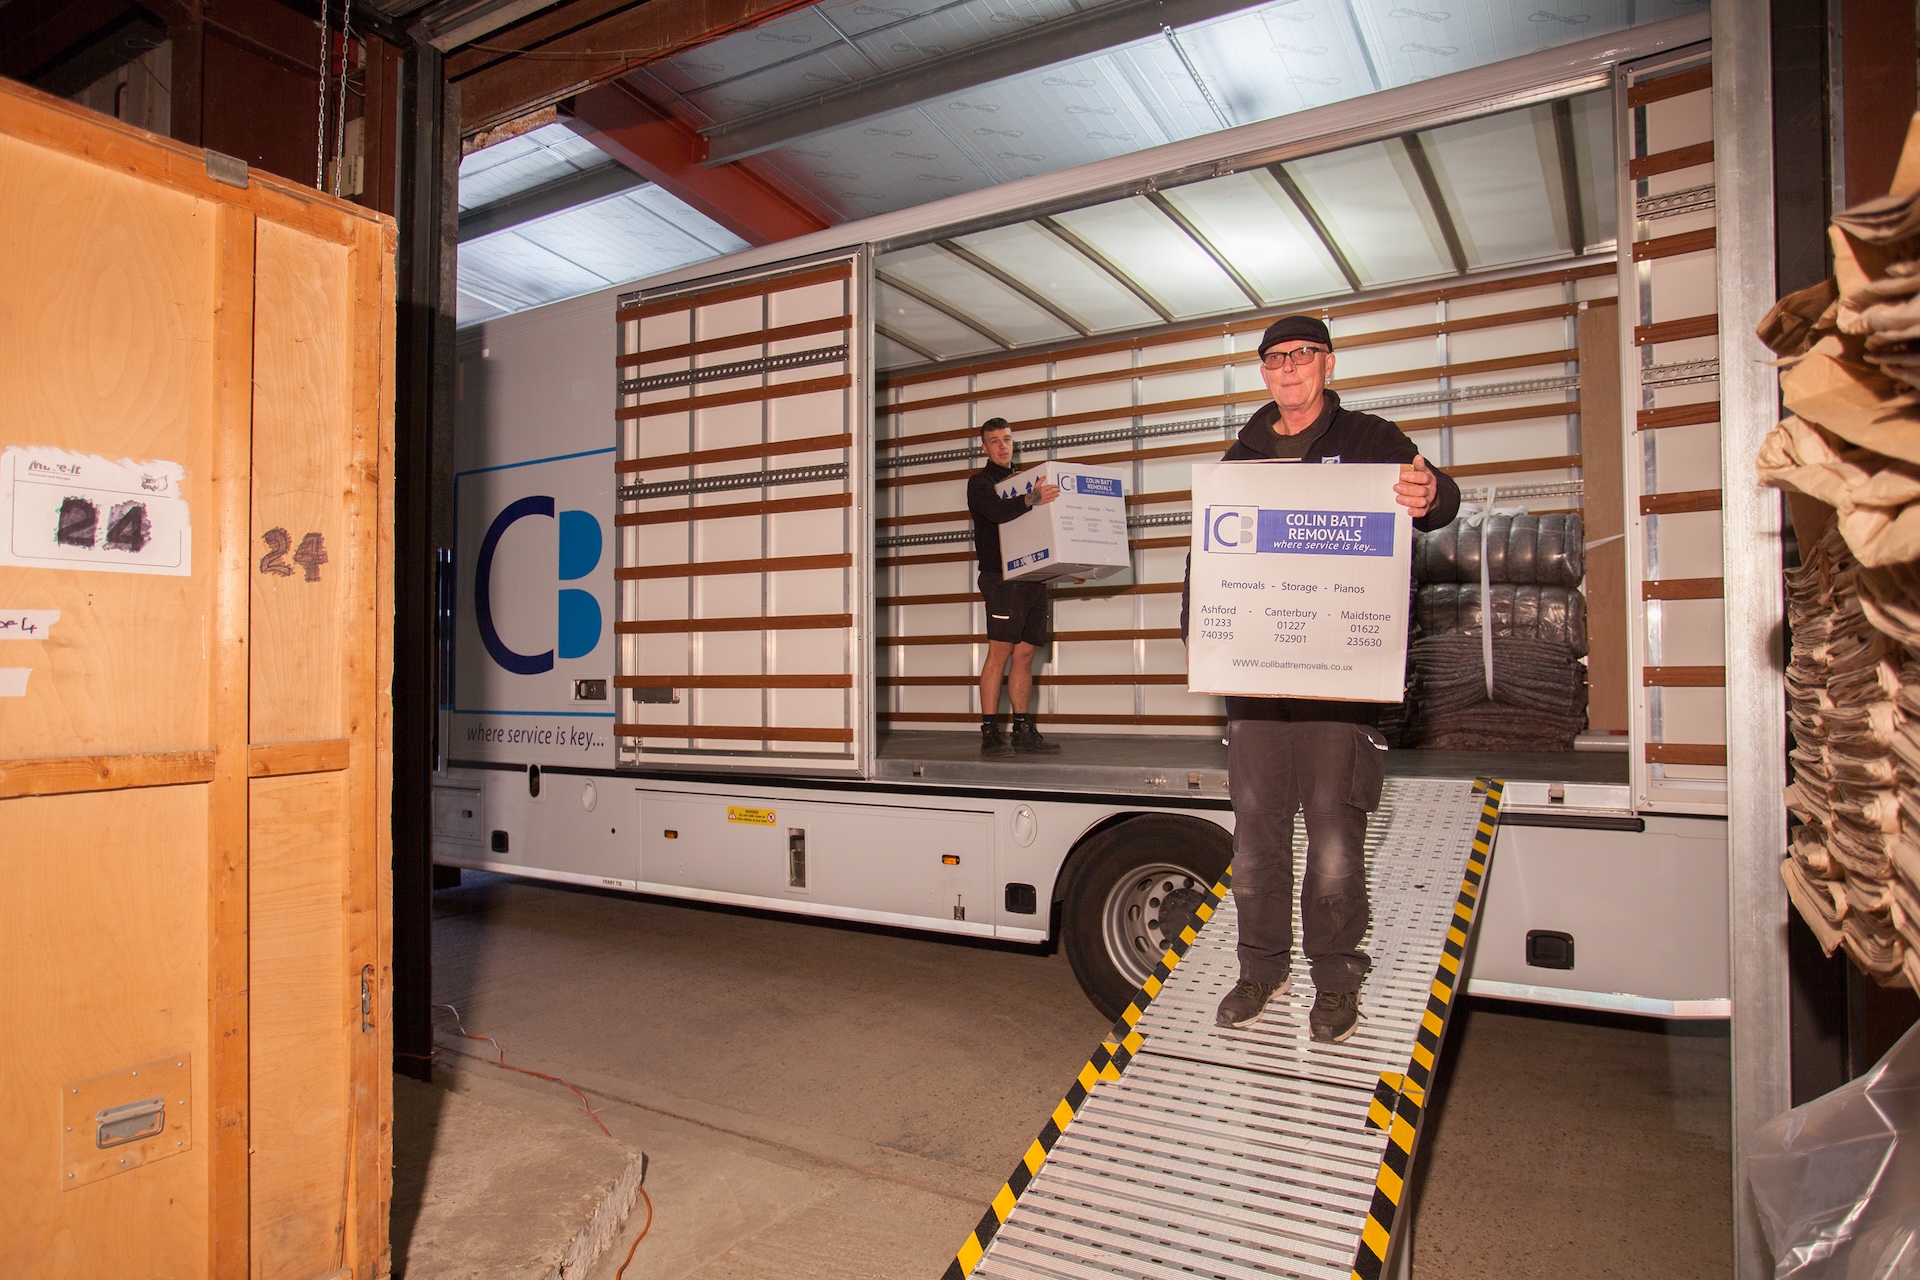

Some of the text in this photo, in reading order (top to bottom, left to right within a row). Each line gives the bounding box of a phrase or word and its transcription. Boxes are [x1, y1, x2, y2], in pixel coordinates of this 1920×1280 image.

[1085, 477, 1113, 486] COLIN BATT
[1087, 483, 1113, 492] REMOVALS
[55, 496, 151, 553] 24
[1286, 513, 1367, 528] COLIN BATT
[1288, 528, 1362, 542] REMOVALS
[1273, 540, 1303, 549] where
[1305, 541, 1339, 550] service
[1342, 541, 1350, 550] is
[259, 526, 328, 583] 24
[1221, 579, 1265, 590] Removals
[1281, 582, 1318, 594] Storage
[1333, 583, 1365, 594] Pianos
[1200, 604, 1237, 615] Ashford
[1264, 607, 1318, 620] Canterbury
[1340, 610, 1391, 621] Maidstone
[1203, 617, 1232, 627] 01233
[1276, 621, 1306, 631] 01227
[1350, 624, 1380, 634] 01622
[1200, 630, 1234, 640] 740395
[1273, 633, 1307, 644] 752901
[1346, 637, 1382, 647] 235630
[467, 722, 504, 743] where
[507, 726, 553, 745] service
[555, 726, 566, 745] is
